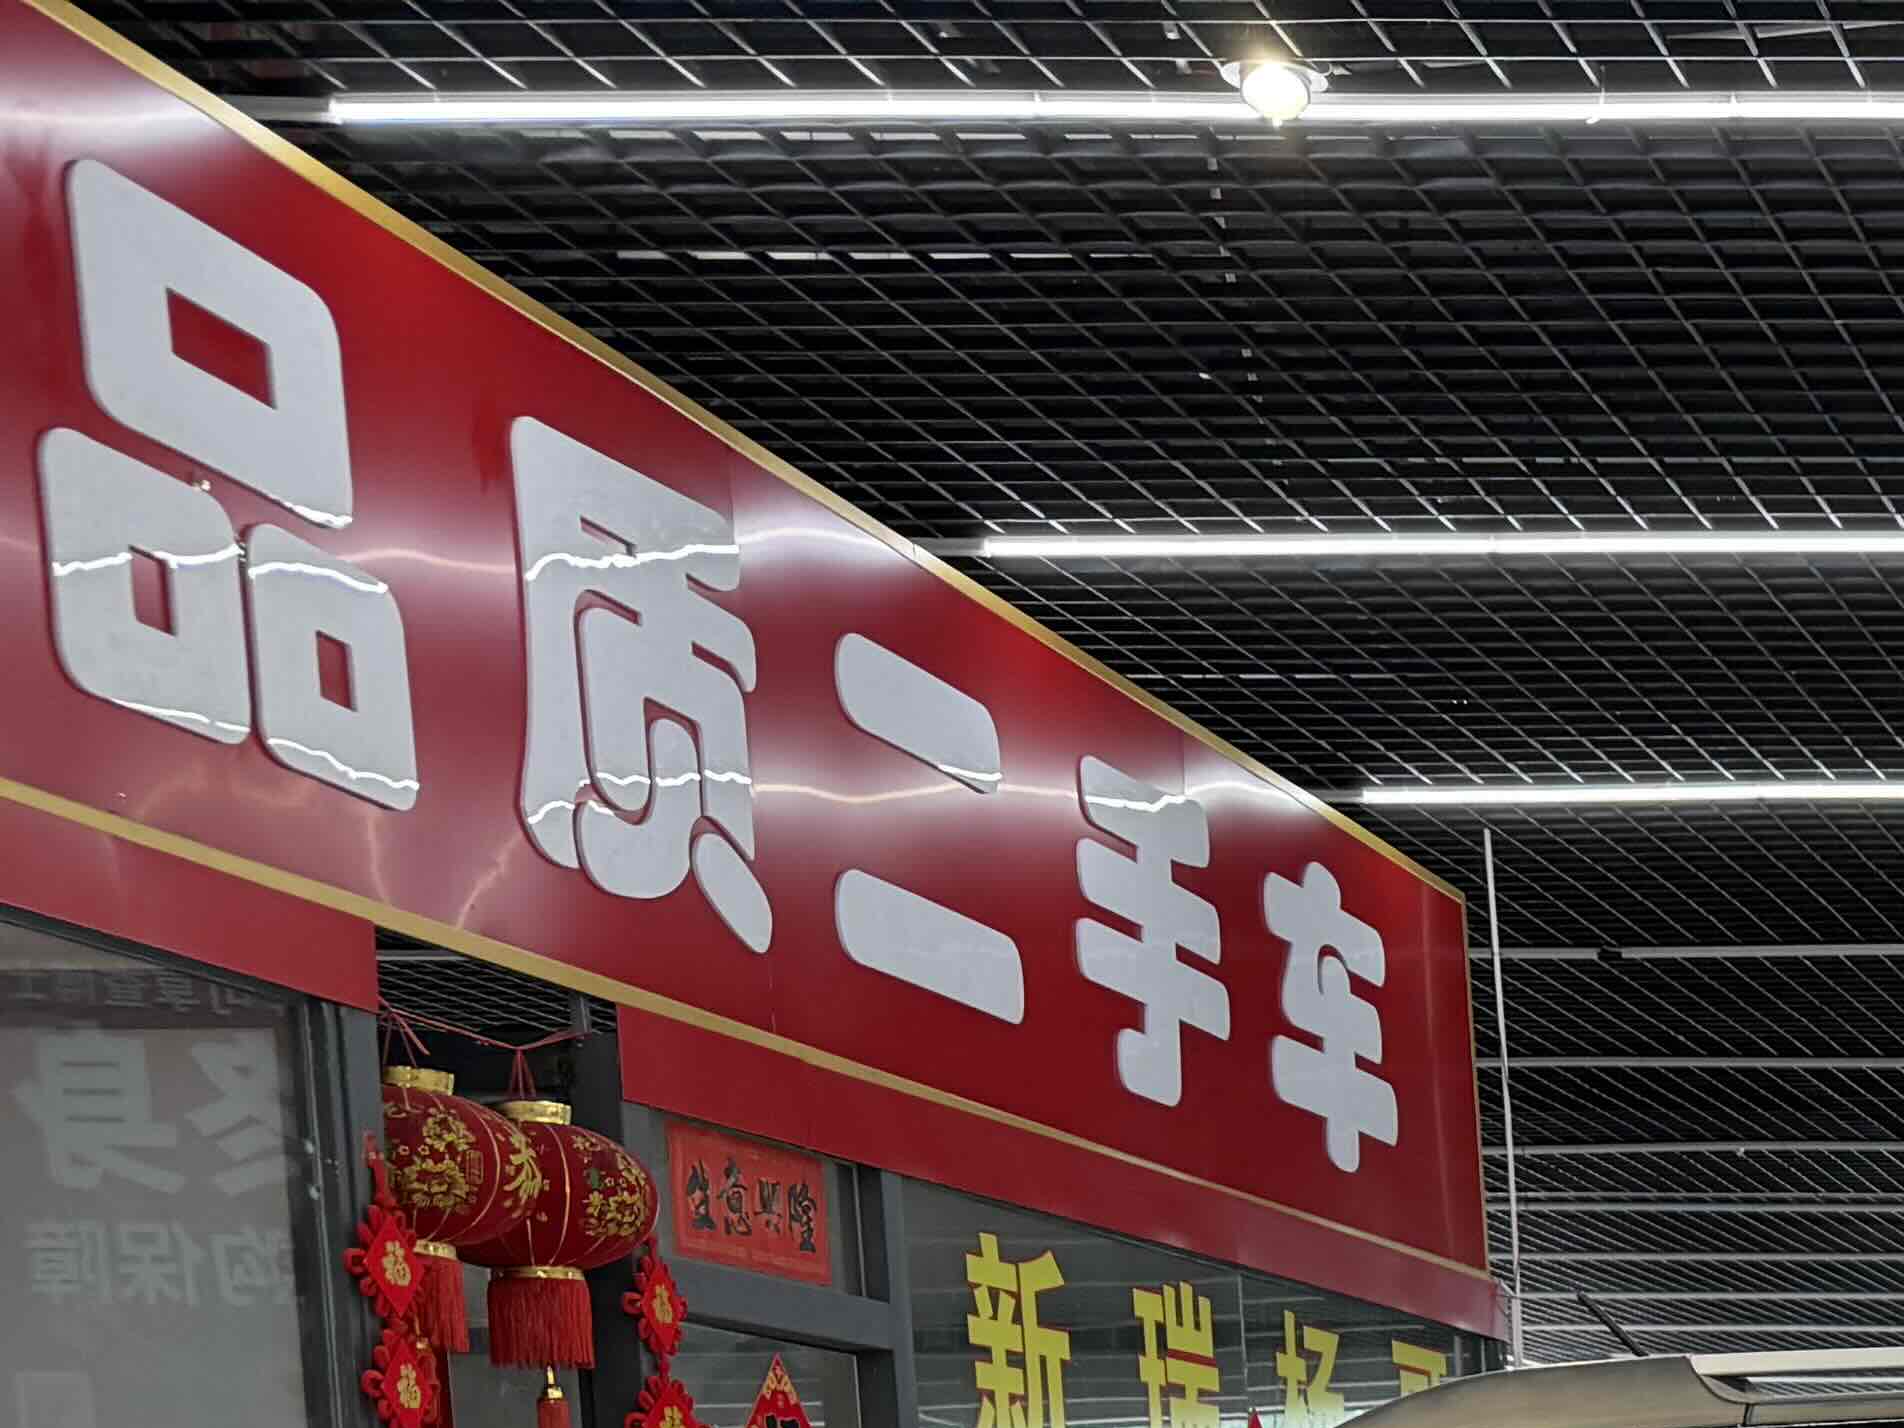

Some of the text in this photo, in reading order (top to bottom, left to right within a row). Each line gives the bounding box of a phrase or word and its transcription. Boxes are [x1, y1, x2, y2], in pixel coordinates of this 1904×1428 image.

[38, 158, 1399, 1173] 品质二手车
[386, 1241, 411, 1285] 福
[653, 1284, 673, 1325] 福
[397, 1364, 420, 1409] 福
